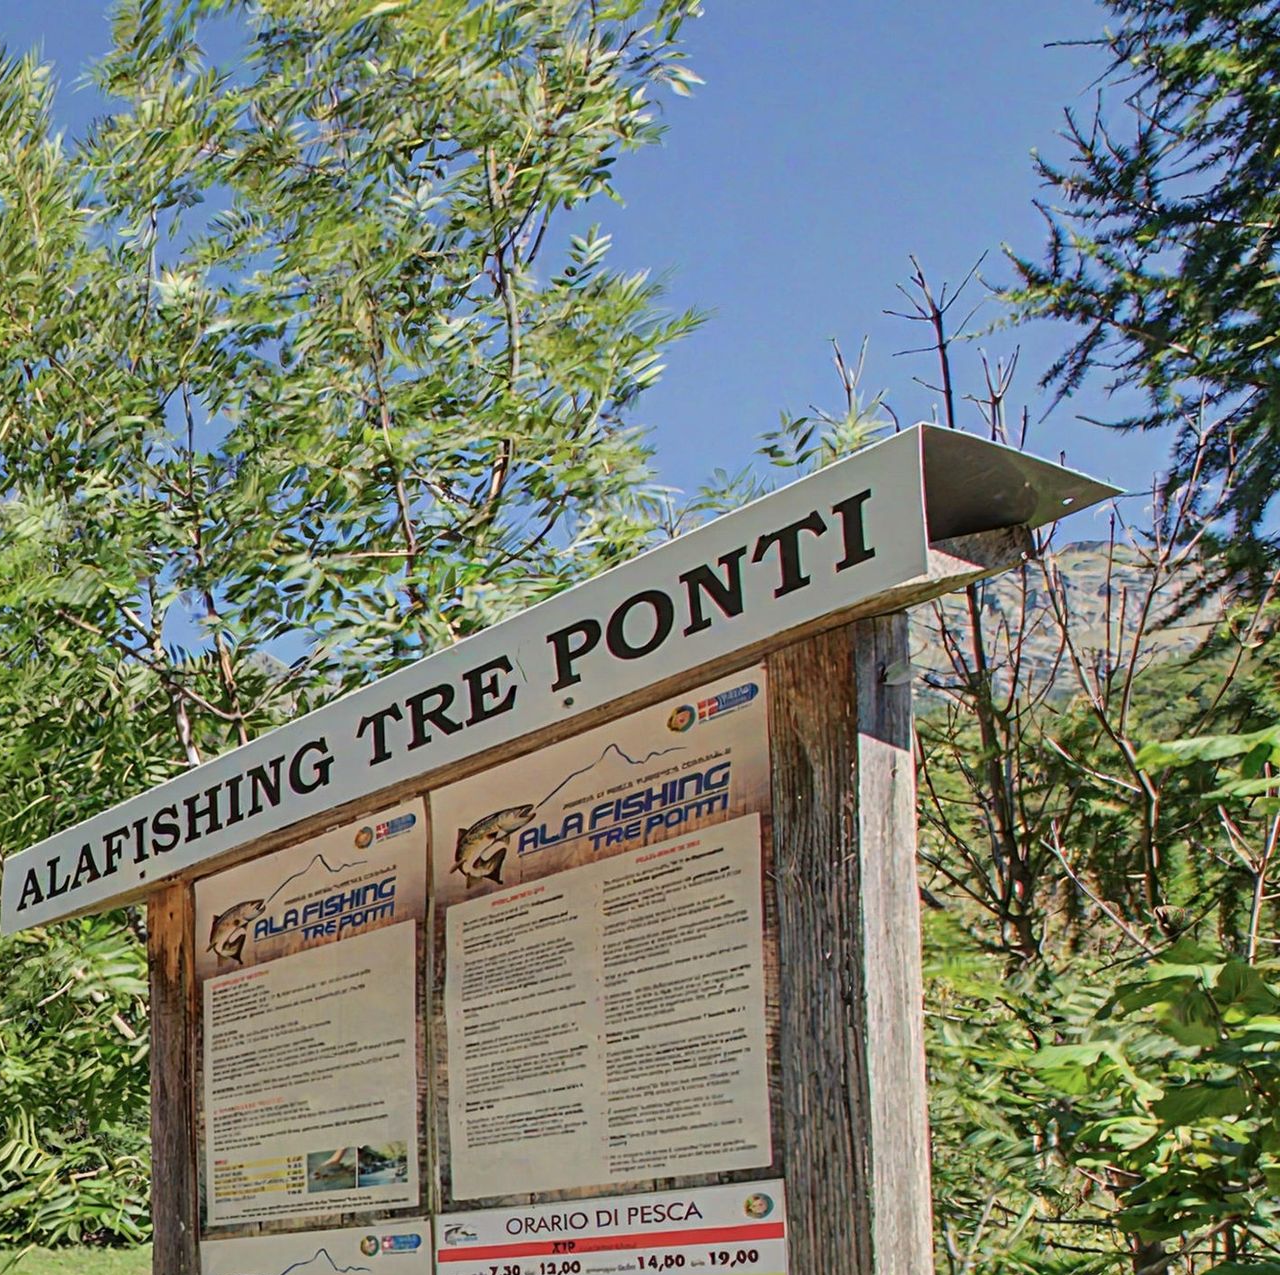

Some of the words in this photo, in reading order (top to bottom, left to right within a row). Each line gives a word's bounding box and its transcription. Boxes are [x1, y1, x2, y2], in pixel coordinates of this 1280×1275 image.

[16, 736, 335, 911] ALAFISHING
[356, 655, 518, 767] TRE
[545, 488, 877, 693] PONTI
[517, 811, 584, 855] ALA
[588, 760, 732, 830] FISHING
[589, 826, 642, 852] TRE
[644, 792, 729, 836] PONTI
[254, 908, 299, 940] ALA
[301, 876, 397, 924] FISHING
[301, 923, 337, 942] TRE
[339, 900, 395, 929] PONTI
[505, 1211, 589, 1236] ORARIO
[596, 1210, 620, 1229] DI
[626, 1200, 704, 1226] PESCA
[708, 1249, 760, 1268] 19,00
